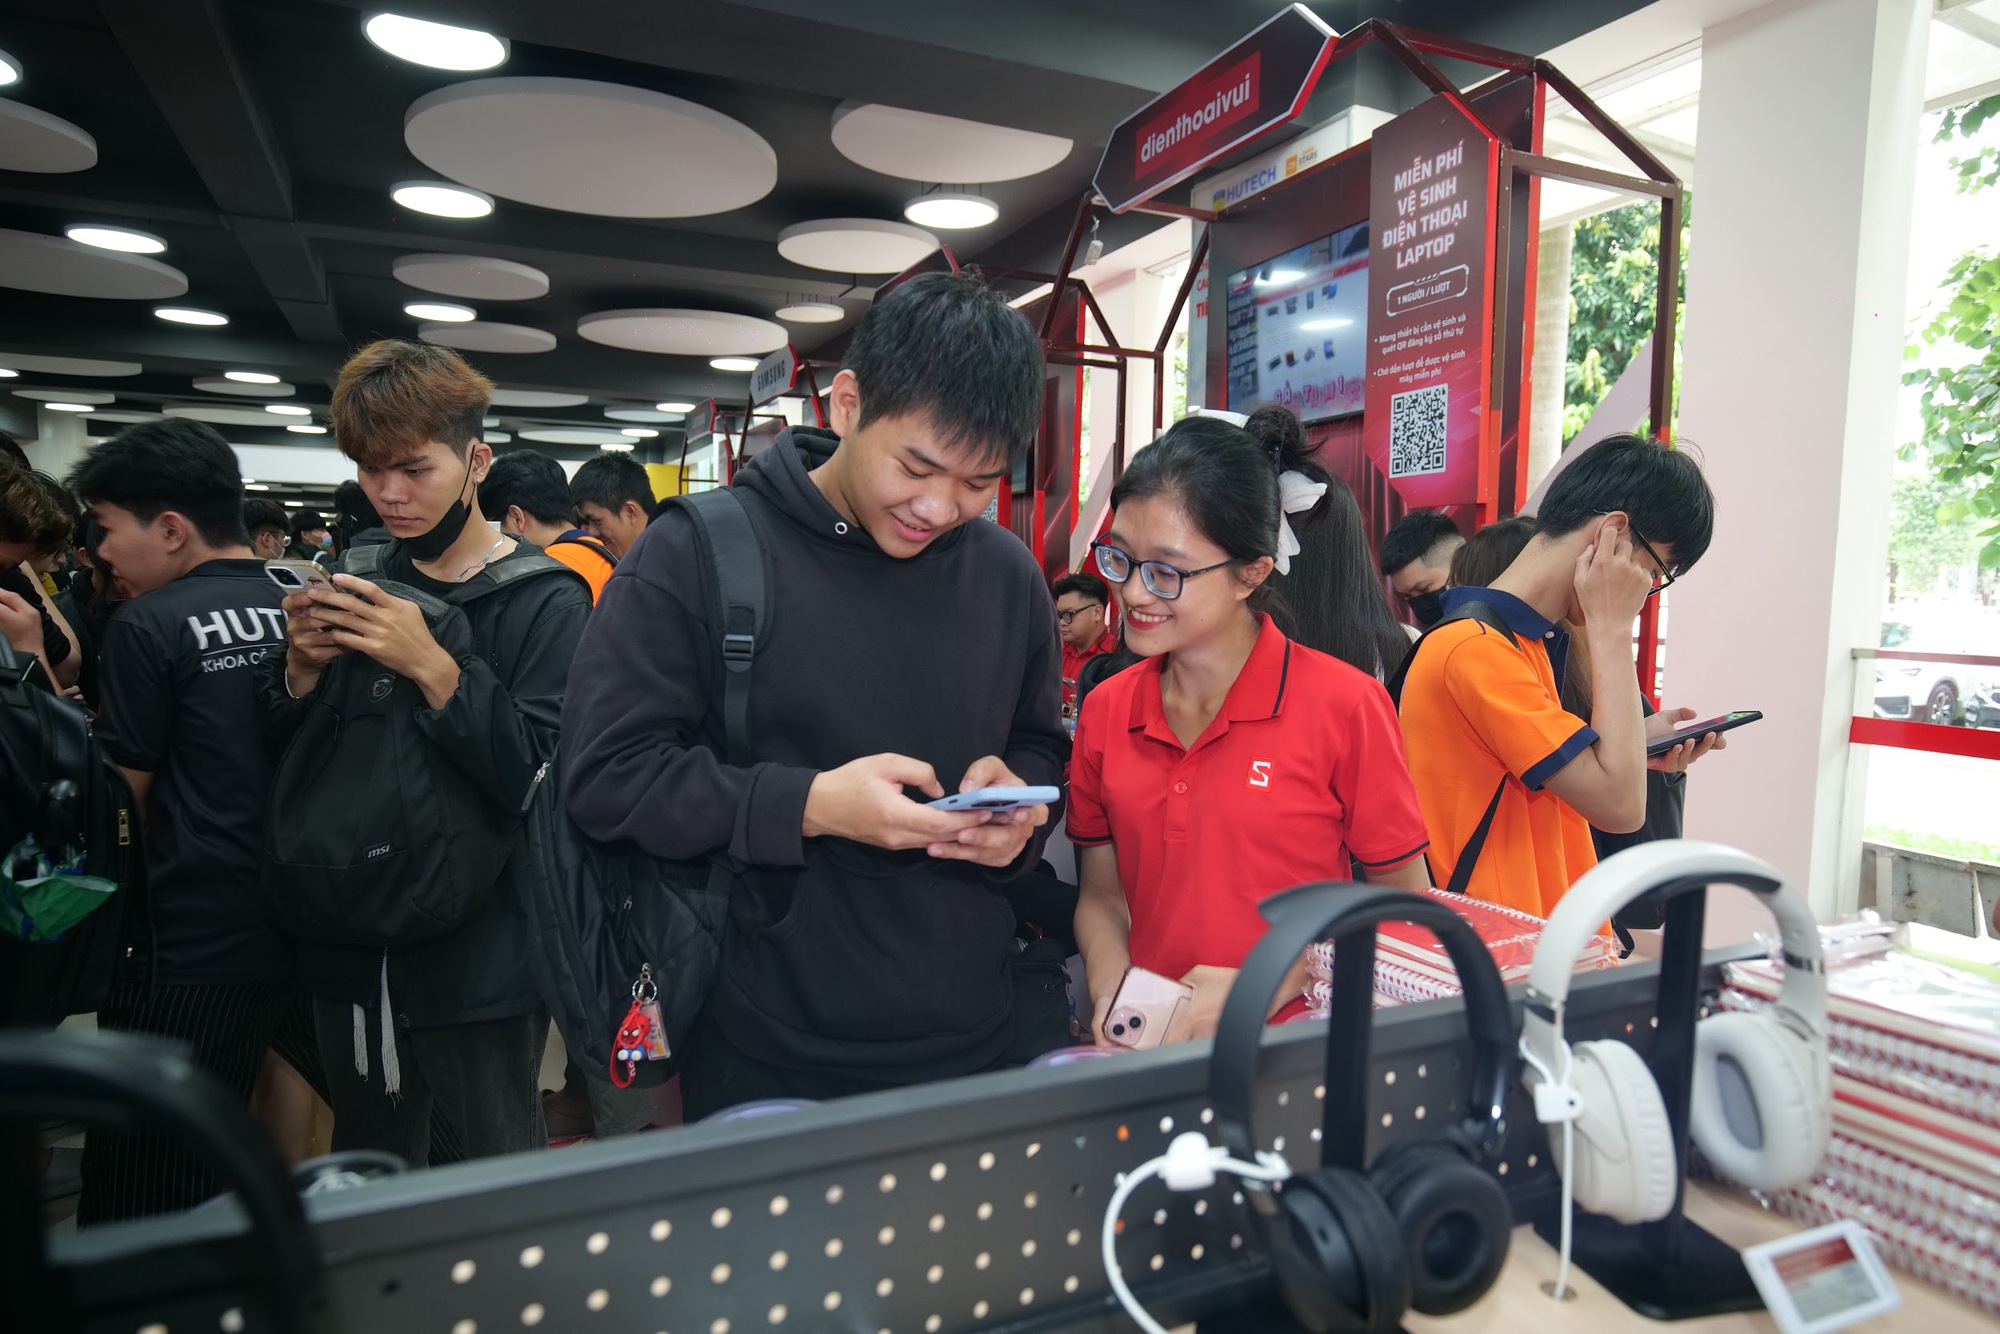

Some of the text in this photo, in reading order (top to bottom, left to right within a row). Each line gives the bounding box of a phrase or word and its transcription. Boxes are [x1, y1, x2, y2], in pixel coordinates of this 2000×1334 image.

[1141, 73, 1250, 162] dienthoaivui
[1395, 140, 1463, 191] MIỄN PHÍ
[1226, 166, 1276, 201] HUTECH
[1398, 176, 1457, 216] VỆ SINH
[1382, 199, 1467, 249] ĐIỆN THOẠI
[1396, 233, 1454, 269] LAPTOP
[1397, 296, 1402, 305] 1
[1379, 333, 1396, 343] Mang
[1442, 315, 1457, 327] sinh
[1458, 313, 1466, 322] và
[1397, 341, 1406, 351] QR
[1451, 349, 1466, 360] sinh
[757, 360, 785, 391] SAMSUNG
[187, 607, 289, 650] HUT
[201, 655, 248, 673] KHOA
[368, 845, 390, 858] msi
